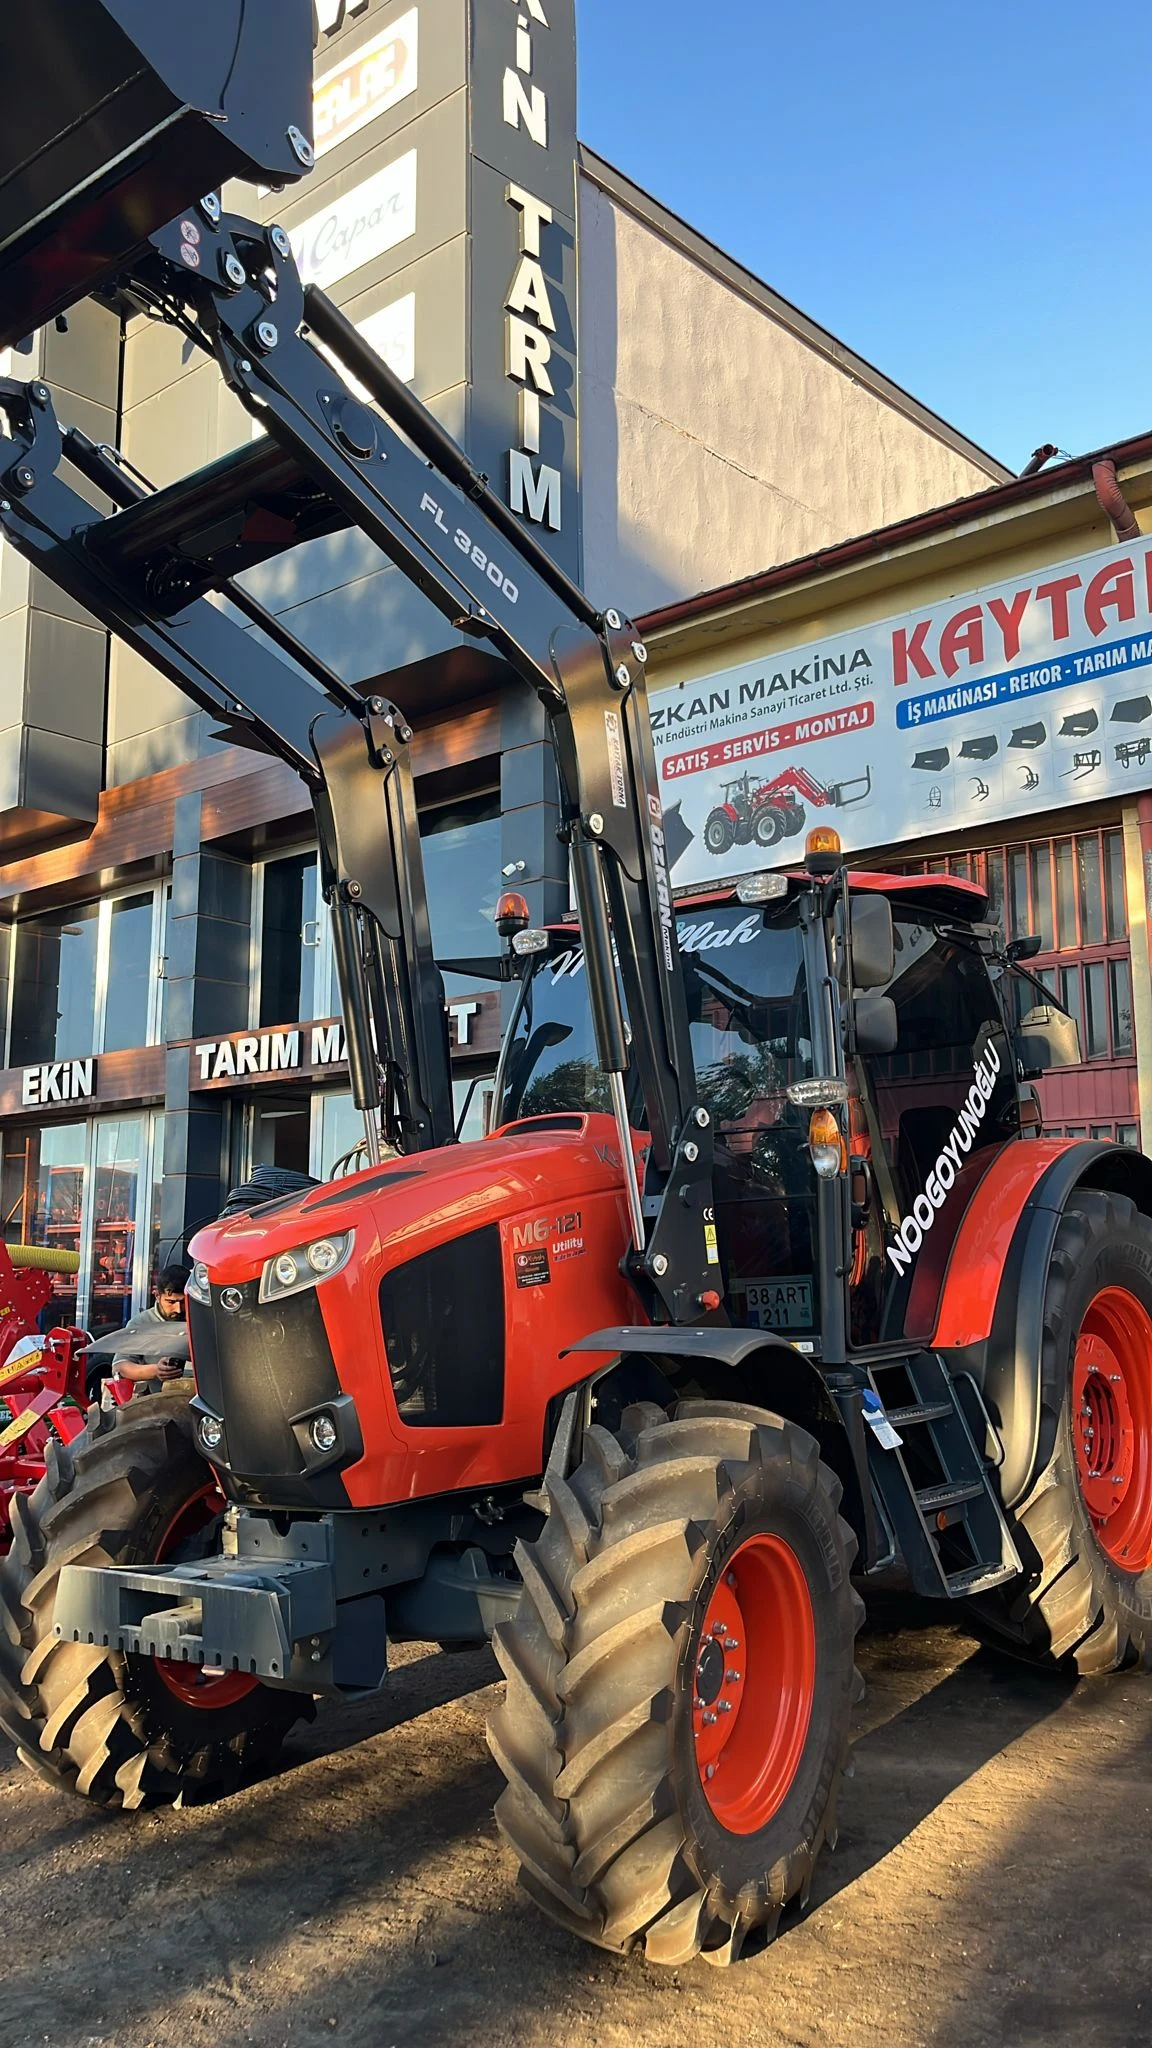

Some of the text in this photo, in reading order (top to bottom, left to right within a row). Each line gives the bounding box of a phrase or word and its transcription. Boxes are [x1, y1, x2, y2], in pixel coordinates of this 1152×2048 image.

[504, 182, 561, 532] TARIM
[420, 492, 519, 604] FL 3800
[892, 550, 1152, 687] KAYTA
[649, 648, 873, 731] ZKAN MAKİNA
[665, 722, 708, 743] Endüstri
[709, 711, 748, 730] Makina
[750, 700, 786, 720] Sanayi
[788, 690, 826, 707] Ticaret
[829, 681, 852, 696] Ltd.
[854, 674, 874, 692] Şti.
[907, 701, 921, 723] İŞ
[924, 681, 997, 716] MAKİNASI
[1009, 665, 1062, 694] REKOR
[1073, 646, 1127, 676] TARIM
[666, 751, 709, 776] SATIŞ
[723, 730, 780, 760] SERVİS
[795, 707, 868, 741] MONTAJ
[195, 1030, 299, 1080] TARIM
[886, 1038, 1000, 1277] NOOGOYUNOĞLU
[512, 1211, 582, 1250] M6-121
[552, 1237, 583, 1254] Utility
[749, 1286, 808, 1306] 38 ART
[763, 1308, 789, 1326] 211
